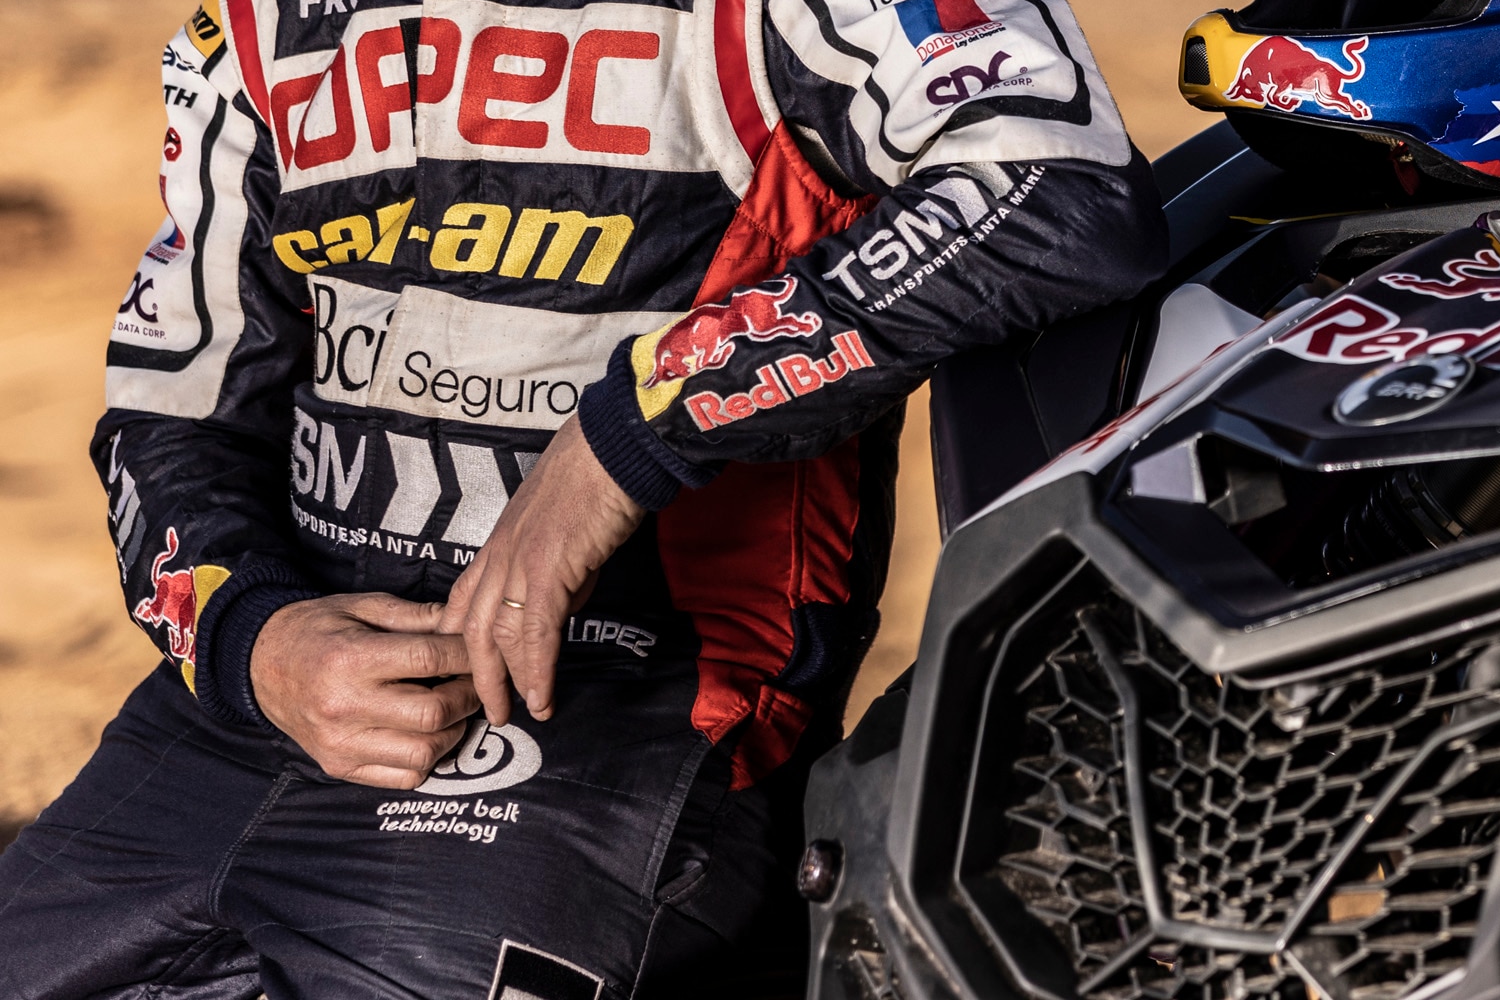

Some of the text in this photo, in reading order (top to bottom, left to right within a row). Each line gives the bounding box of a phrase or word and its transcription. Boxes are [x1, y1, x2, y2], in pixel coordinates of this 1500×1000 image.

[916, 21, 1002, 62] Donaciones
[1009, 164, 1046, 206] MARI
[822, 199, 962, 301] TSM
[399, 350, 580, 418] Seguro
[685, 330, 876, 432] Red Bull
[356, 527, 437, 560] SANTA
[377, 799, 520, 822] conveyor belt
[379, 816, 498, 843] technology
